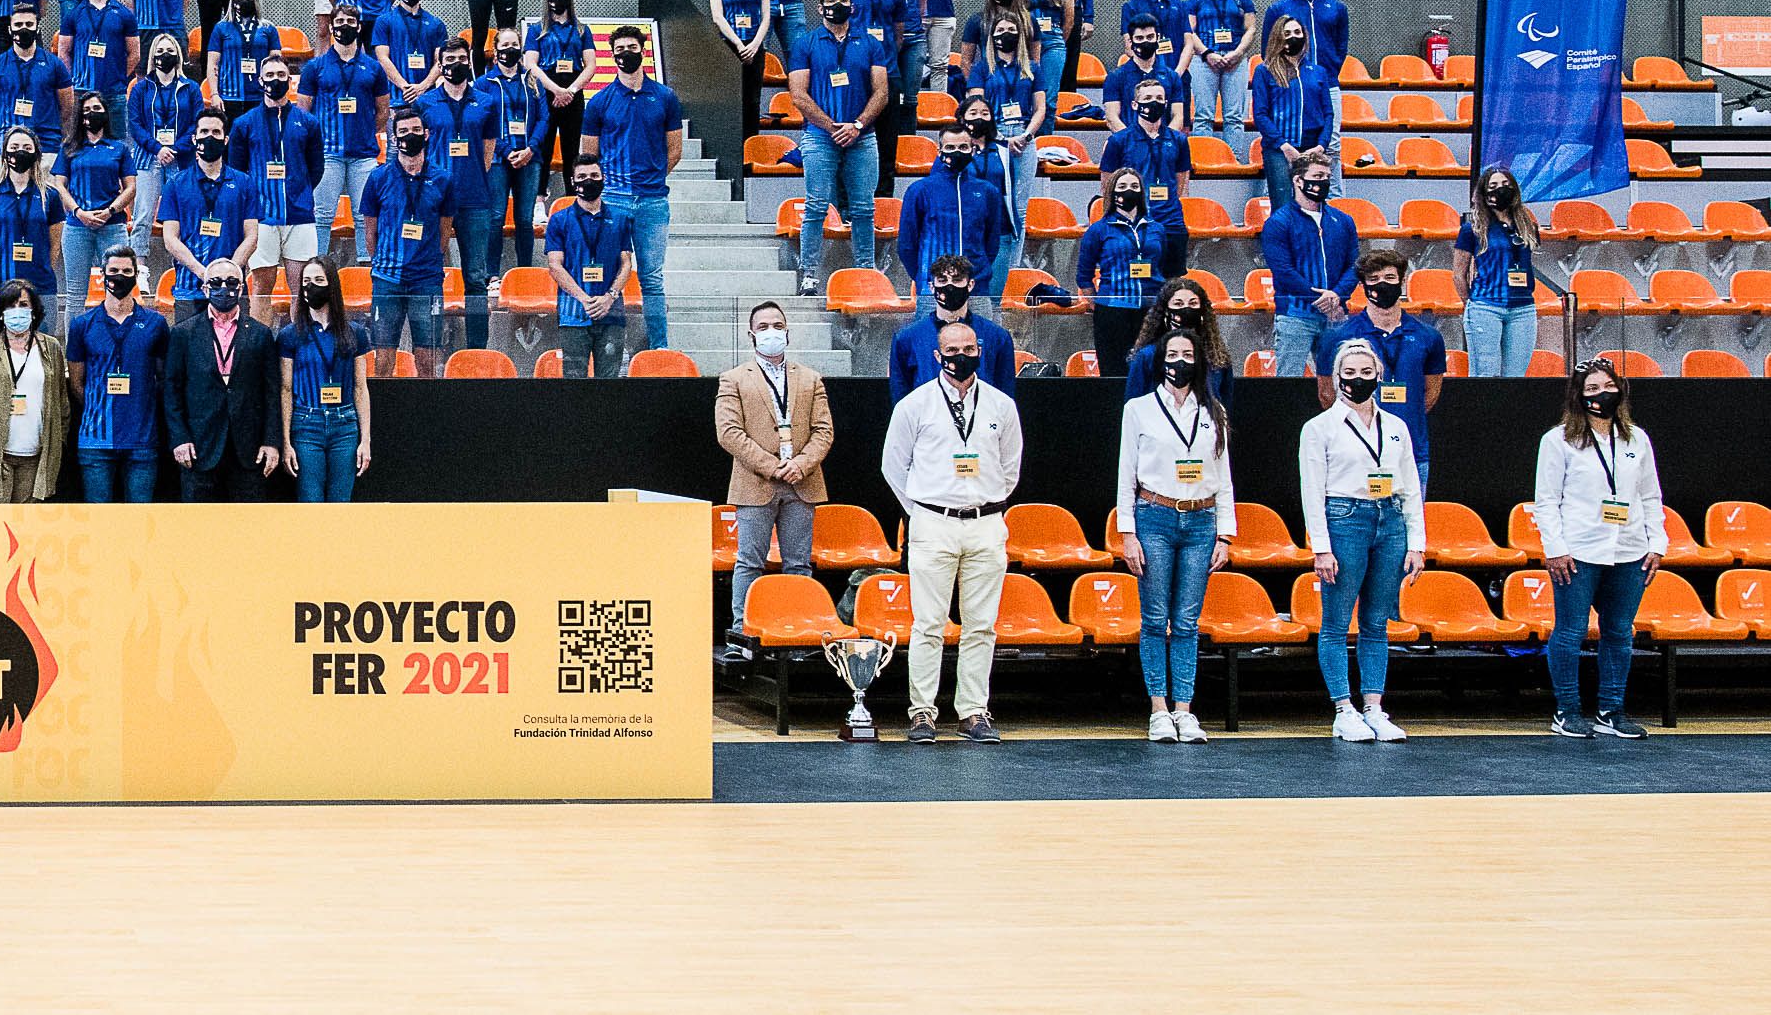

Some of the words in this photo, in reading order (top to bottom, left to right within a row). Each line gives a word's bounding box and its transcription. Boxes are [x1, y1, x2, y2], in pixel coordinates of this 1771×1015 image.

[1566, 60, 1600, 70] Español
[294, 600, 516, 644] PROYECTO
[312, 653, 386, 695] FER
[402, 652, 510, 695] 2021
[523, 714, 568, 724] Consulta
[570, 714, 579, 724] la
[629, 714, 642, 724] de
[644, 714, 653, 724] la
[514, 727, 566, 737] Fundación
[569, 727, 611, 737] Trinidad
[613, 727, 653, 737] Alfonso
